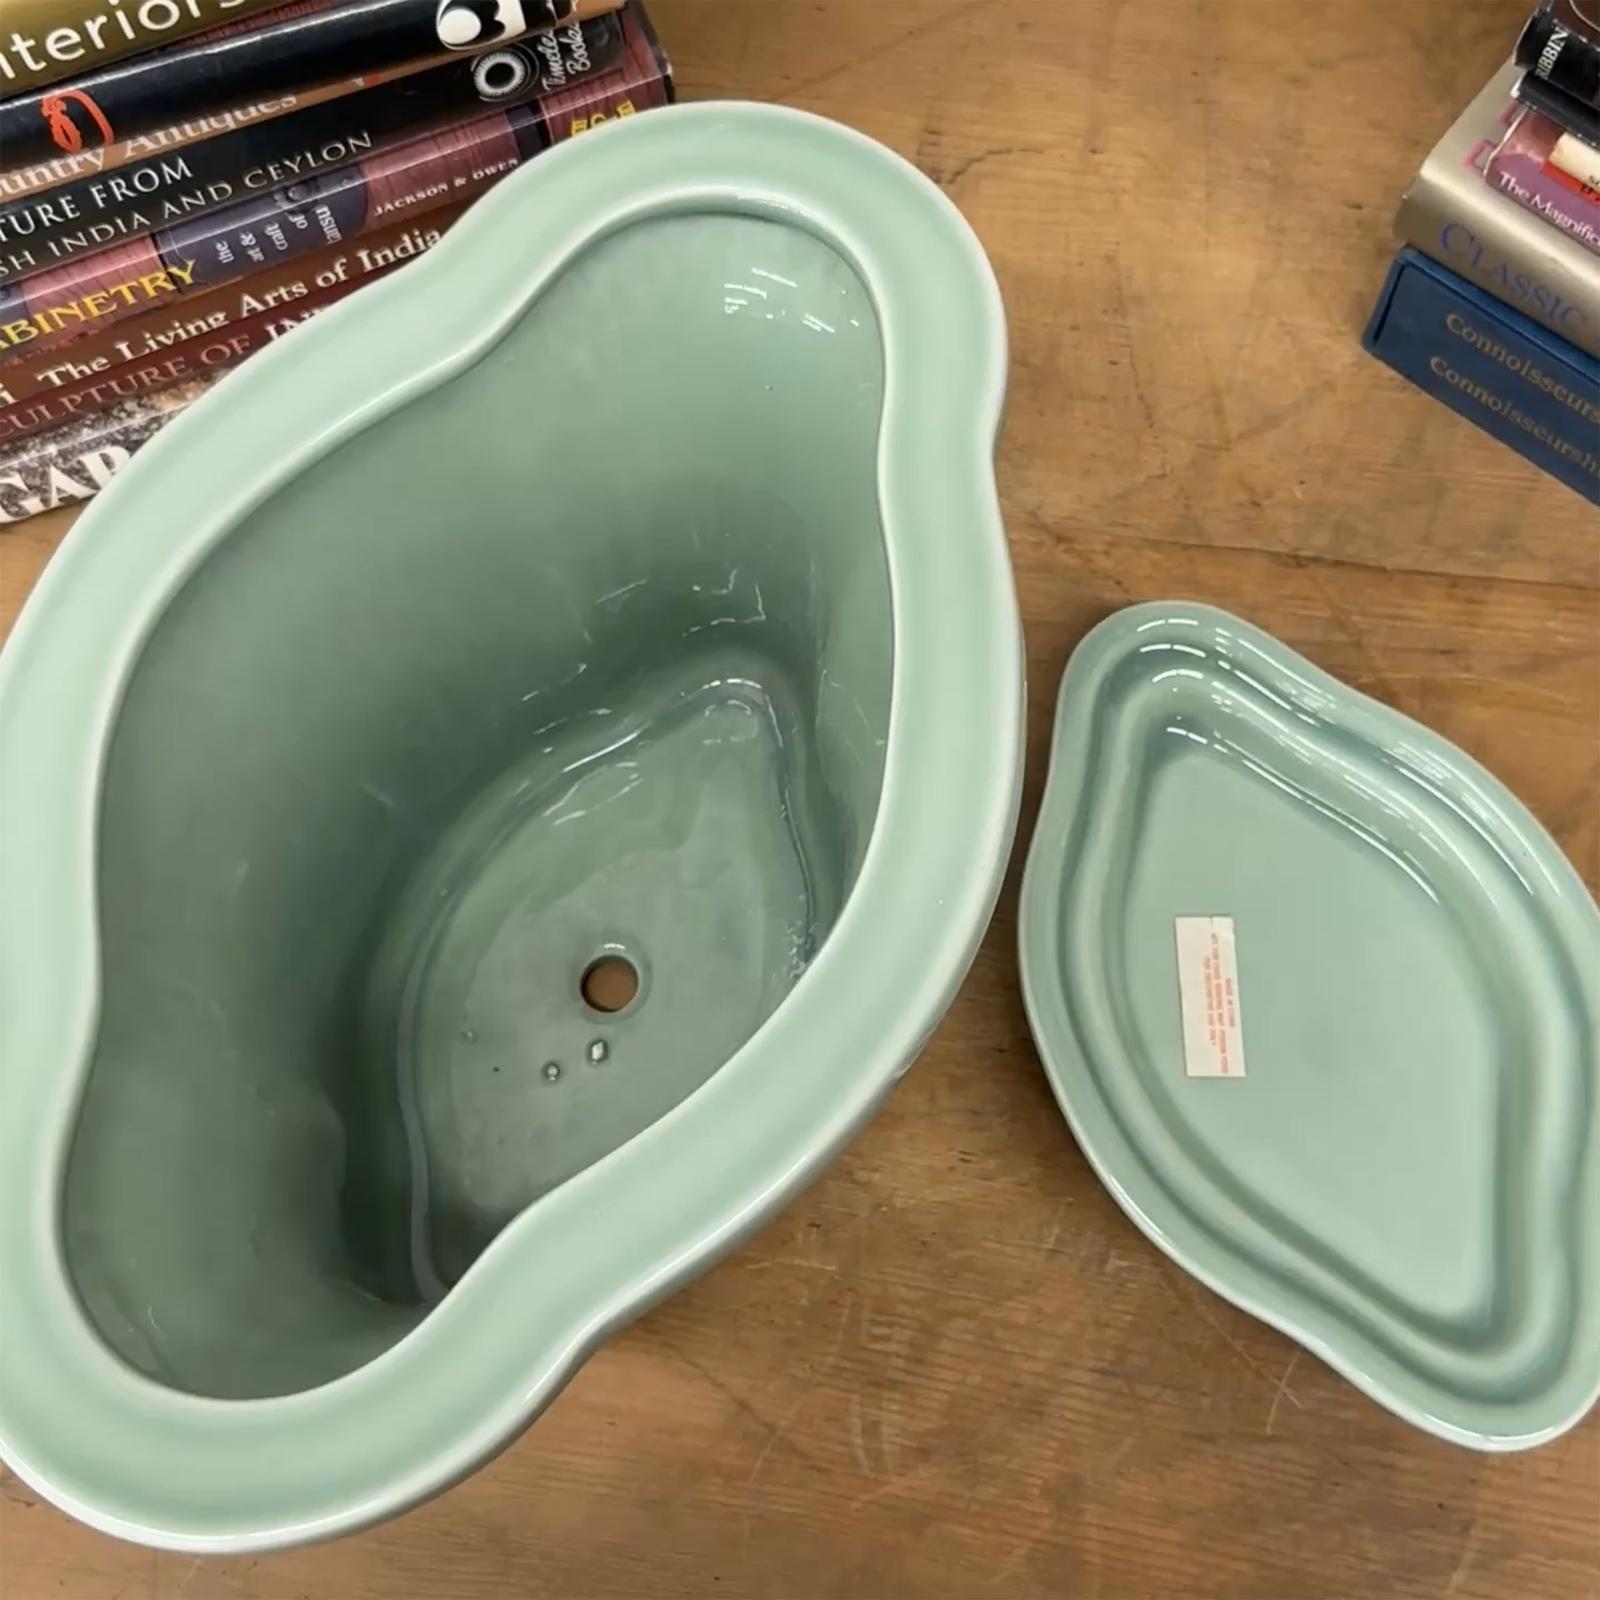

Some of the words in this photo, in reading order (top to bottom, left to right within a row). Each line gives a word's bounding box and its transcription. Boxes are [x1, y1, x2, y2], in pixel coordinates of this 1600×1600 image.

[48, 212, 151, 256] INDIA
[163, 183, 233, 219] AND
[244, 131, 373, 188] CEYLON
[89, 156, 194, 208] FROM
[373, 182, 449, 217] JACKSON
[453, 176, 468, 188] &
[472, 157, 519, 181] OWEN
[1500, 172, 1529, 199] The
[37, 356, 111, 387] The
[114, 311, 230, 361] Living
[241, 282, 308, 319] Arts
[316, 258, 350, 288] of
[357, 229, 441, 273] India
[201, 334, 250, 366] OF
